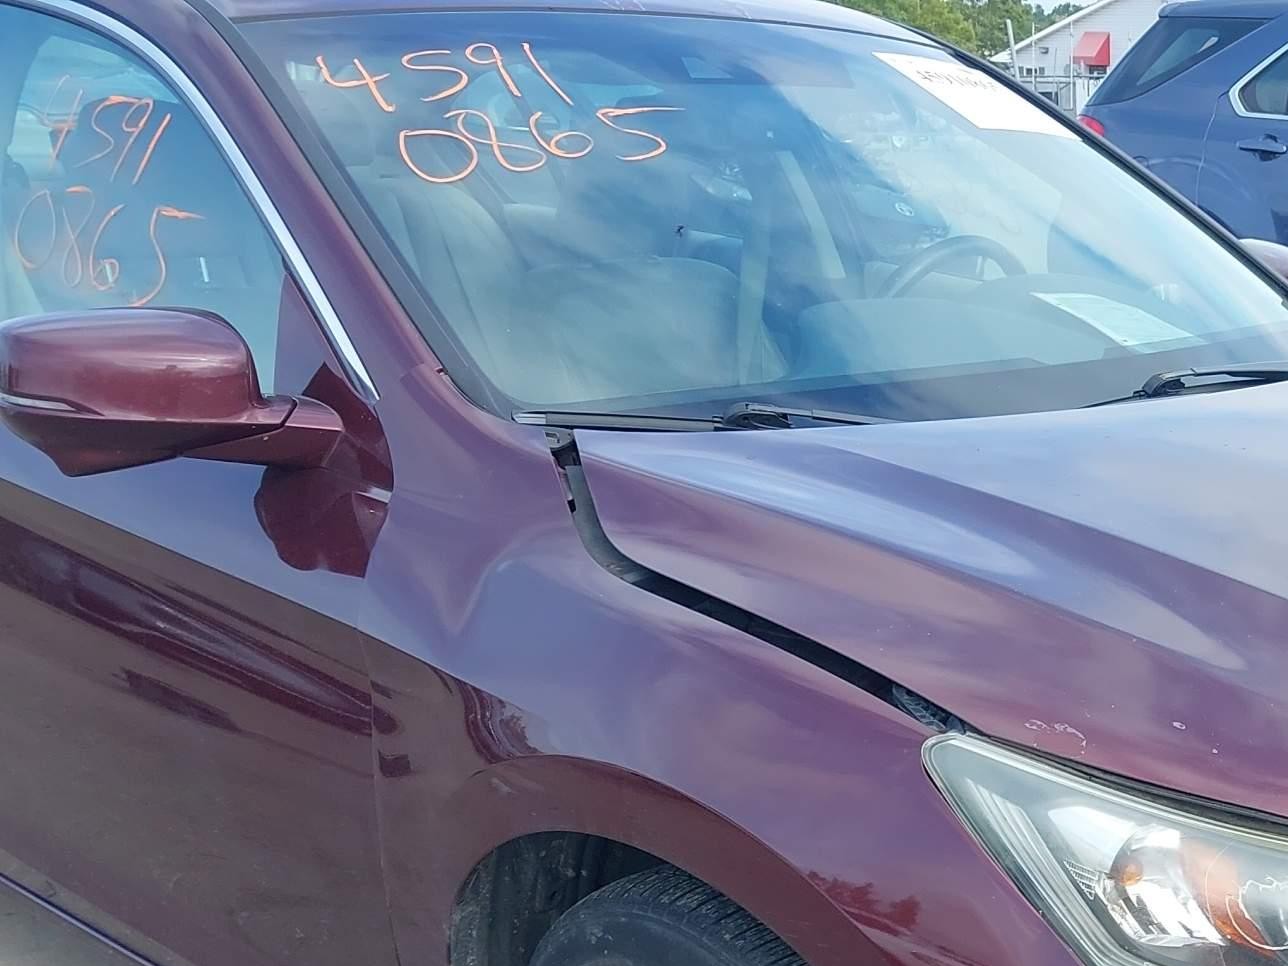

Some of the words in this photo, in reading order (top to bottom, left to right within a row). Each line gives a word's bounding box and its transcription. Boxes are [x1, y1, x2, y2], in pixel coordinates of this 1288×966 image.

[315, 41, 575, 113] 4591
[43, 73, 172, 185] 4591
[398, 106, 687, 183] 0865
[14, 185, 206, 308] 0865
